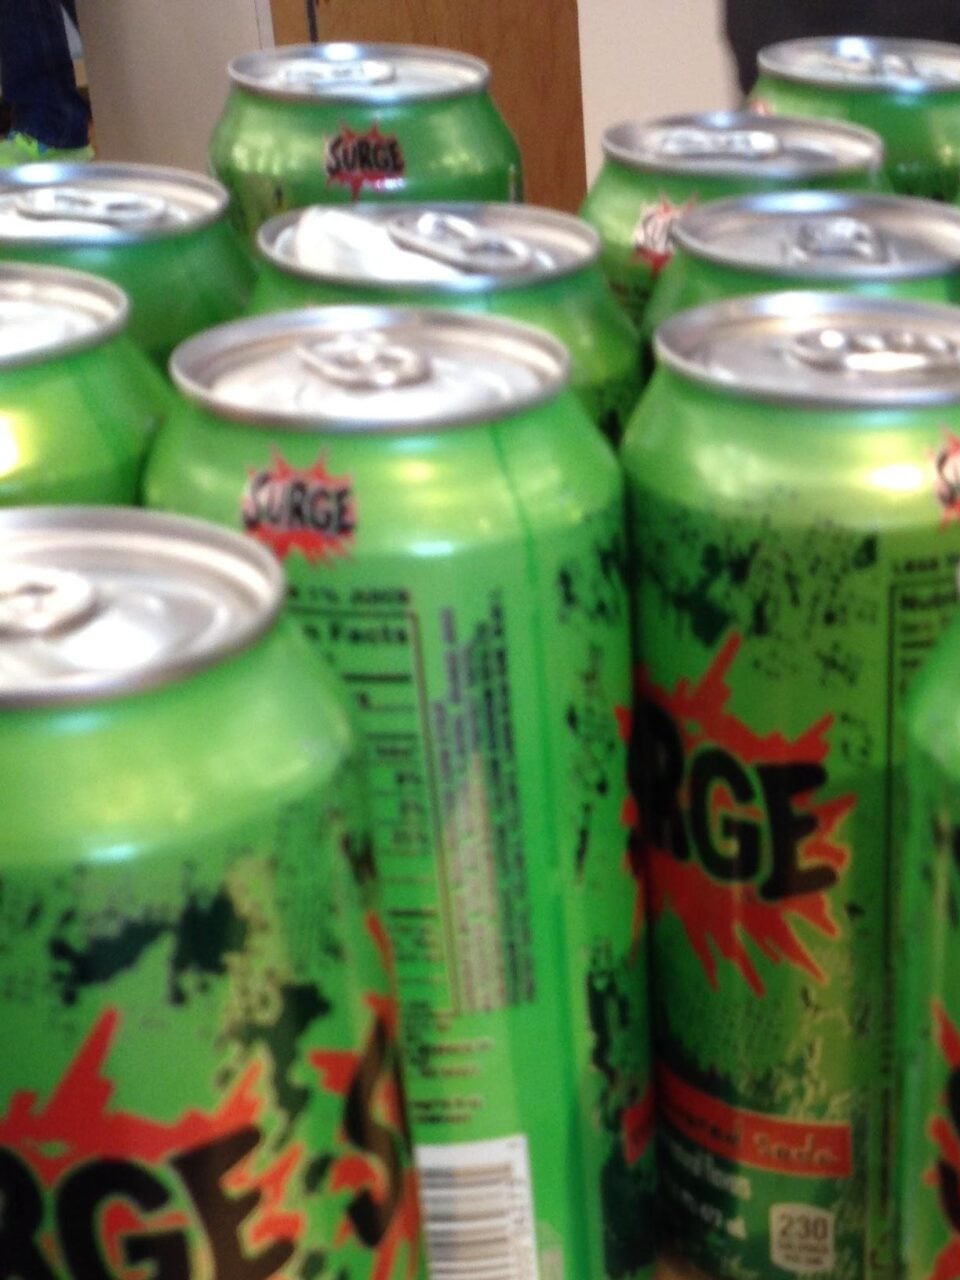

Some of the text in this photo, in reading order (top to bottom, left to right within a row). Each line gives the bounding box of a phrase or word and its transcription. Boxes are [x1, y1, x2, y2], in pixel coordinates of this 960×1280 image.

[326, 135, 405, 177] SURGE
[243, 471, 354, 536] SURGE
[778, 1211, 829, 1241] 230
